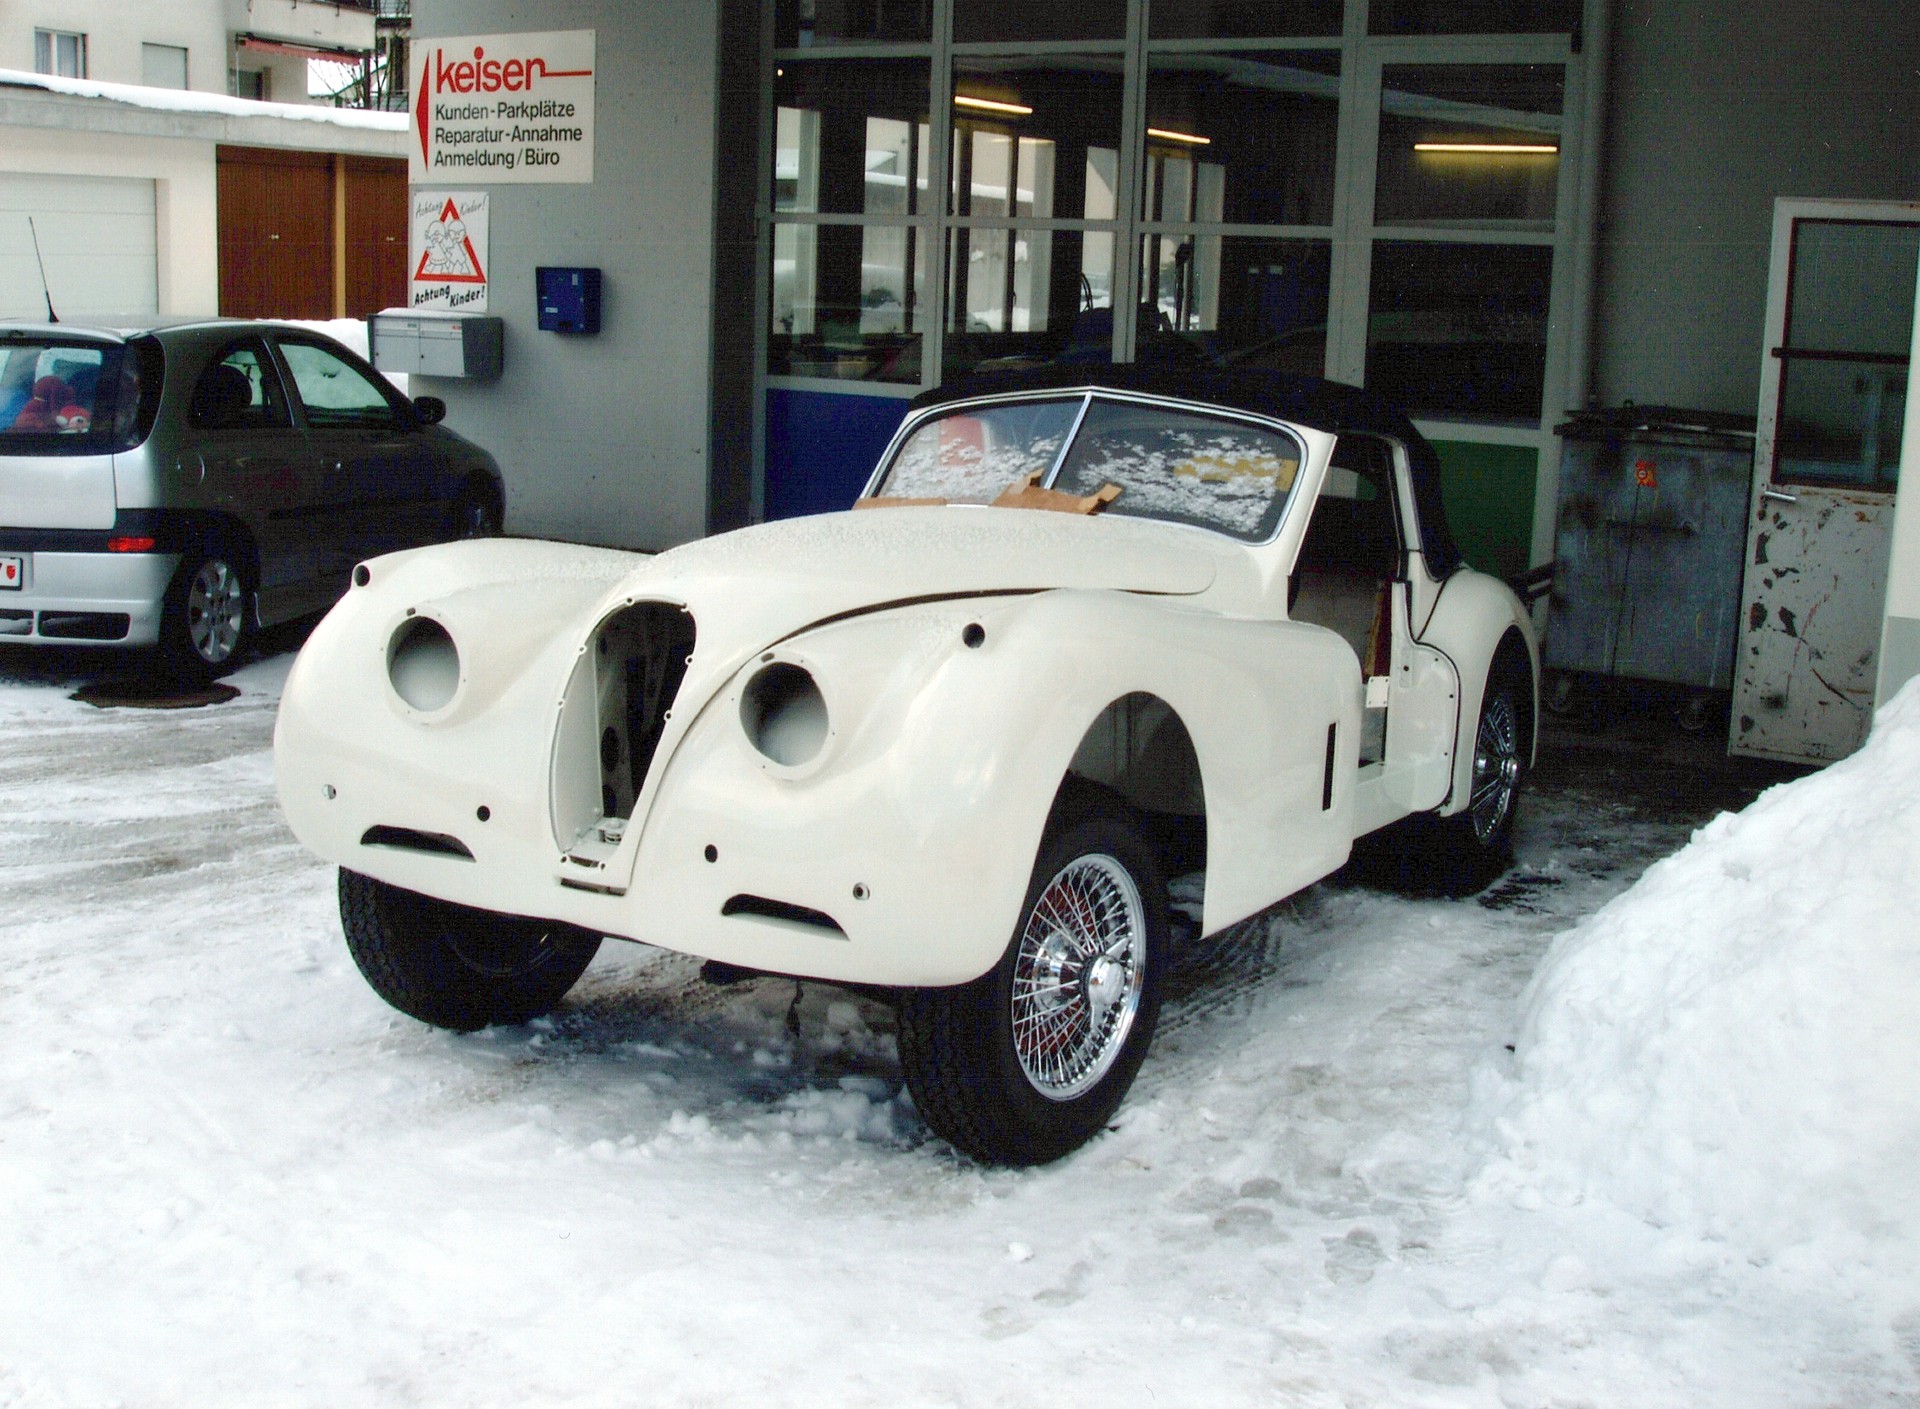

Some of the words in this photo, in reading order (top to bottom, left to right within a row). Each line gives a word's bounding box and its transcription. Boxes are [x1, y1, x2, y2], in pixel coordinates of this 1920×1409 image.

[436, 46, 592, 93] keiser
[414, 285, 451, 306] Achtung
[450, 285, 486, 307] Kinder!
